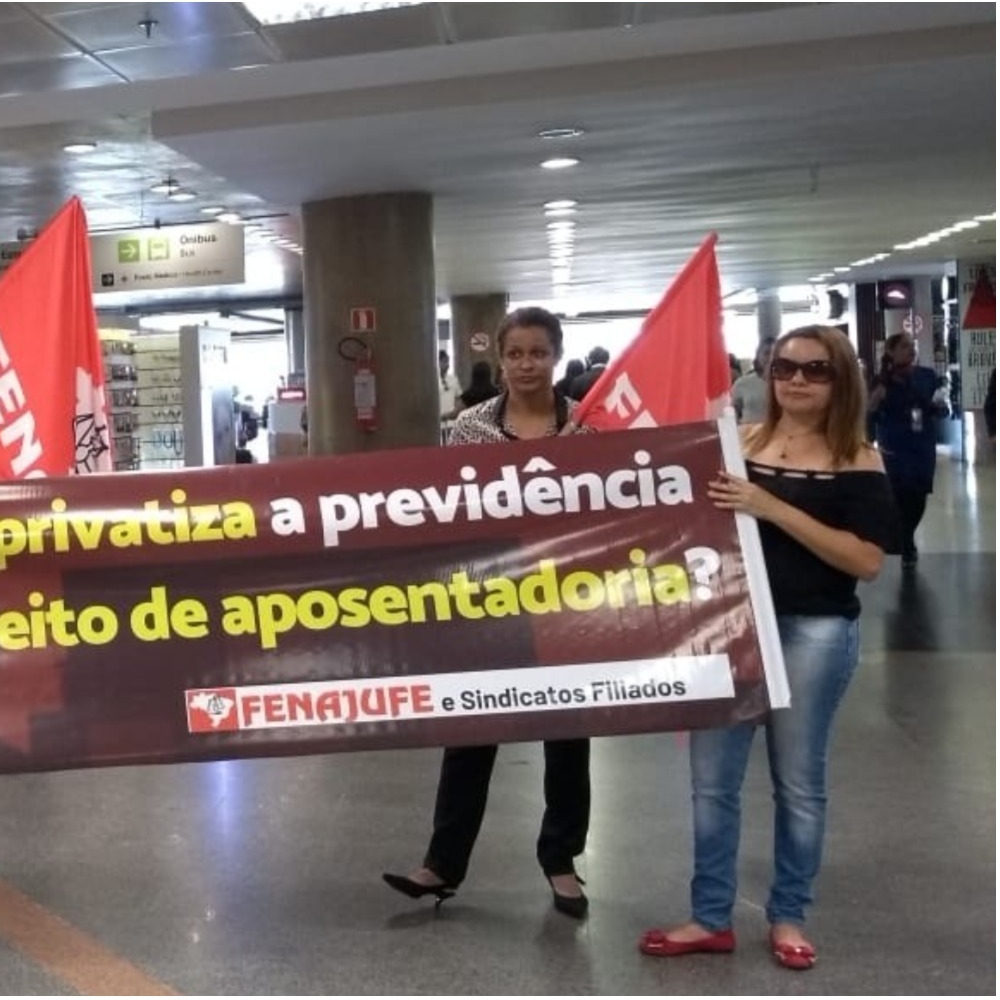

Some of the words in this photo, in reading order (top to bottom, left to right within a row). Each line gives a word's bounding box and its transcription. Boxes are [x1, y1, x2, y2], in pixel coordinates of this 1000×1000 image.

[271, 497, 307, 534] a
[318, 450, 695, 548] previdência
[131, 587, 211, 644] de
[221, 544, 723, 650] aposentadoria?
[240, 685, 434, 727] FENAJUFE
[441, 695, 454, 712] e
[460, 685, 586, 711] Sindicatos
[591, 677, 687, 702] Filiados
